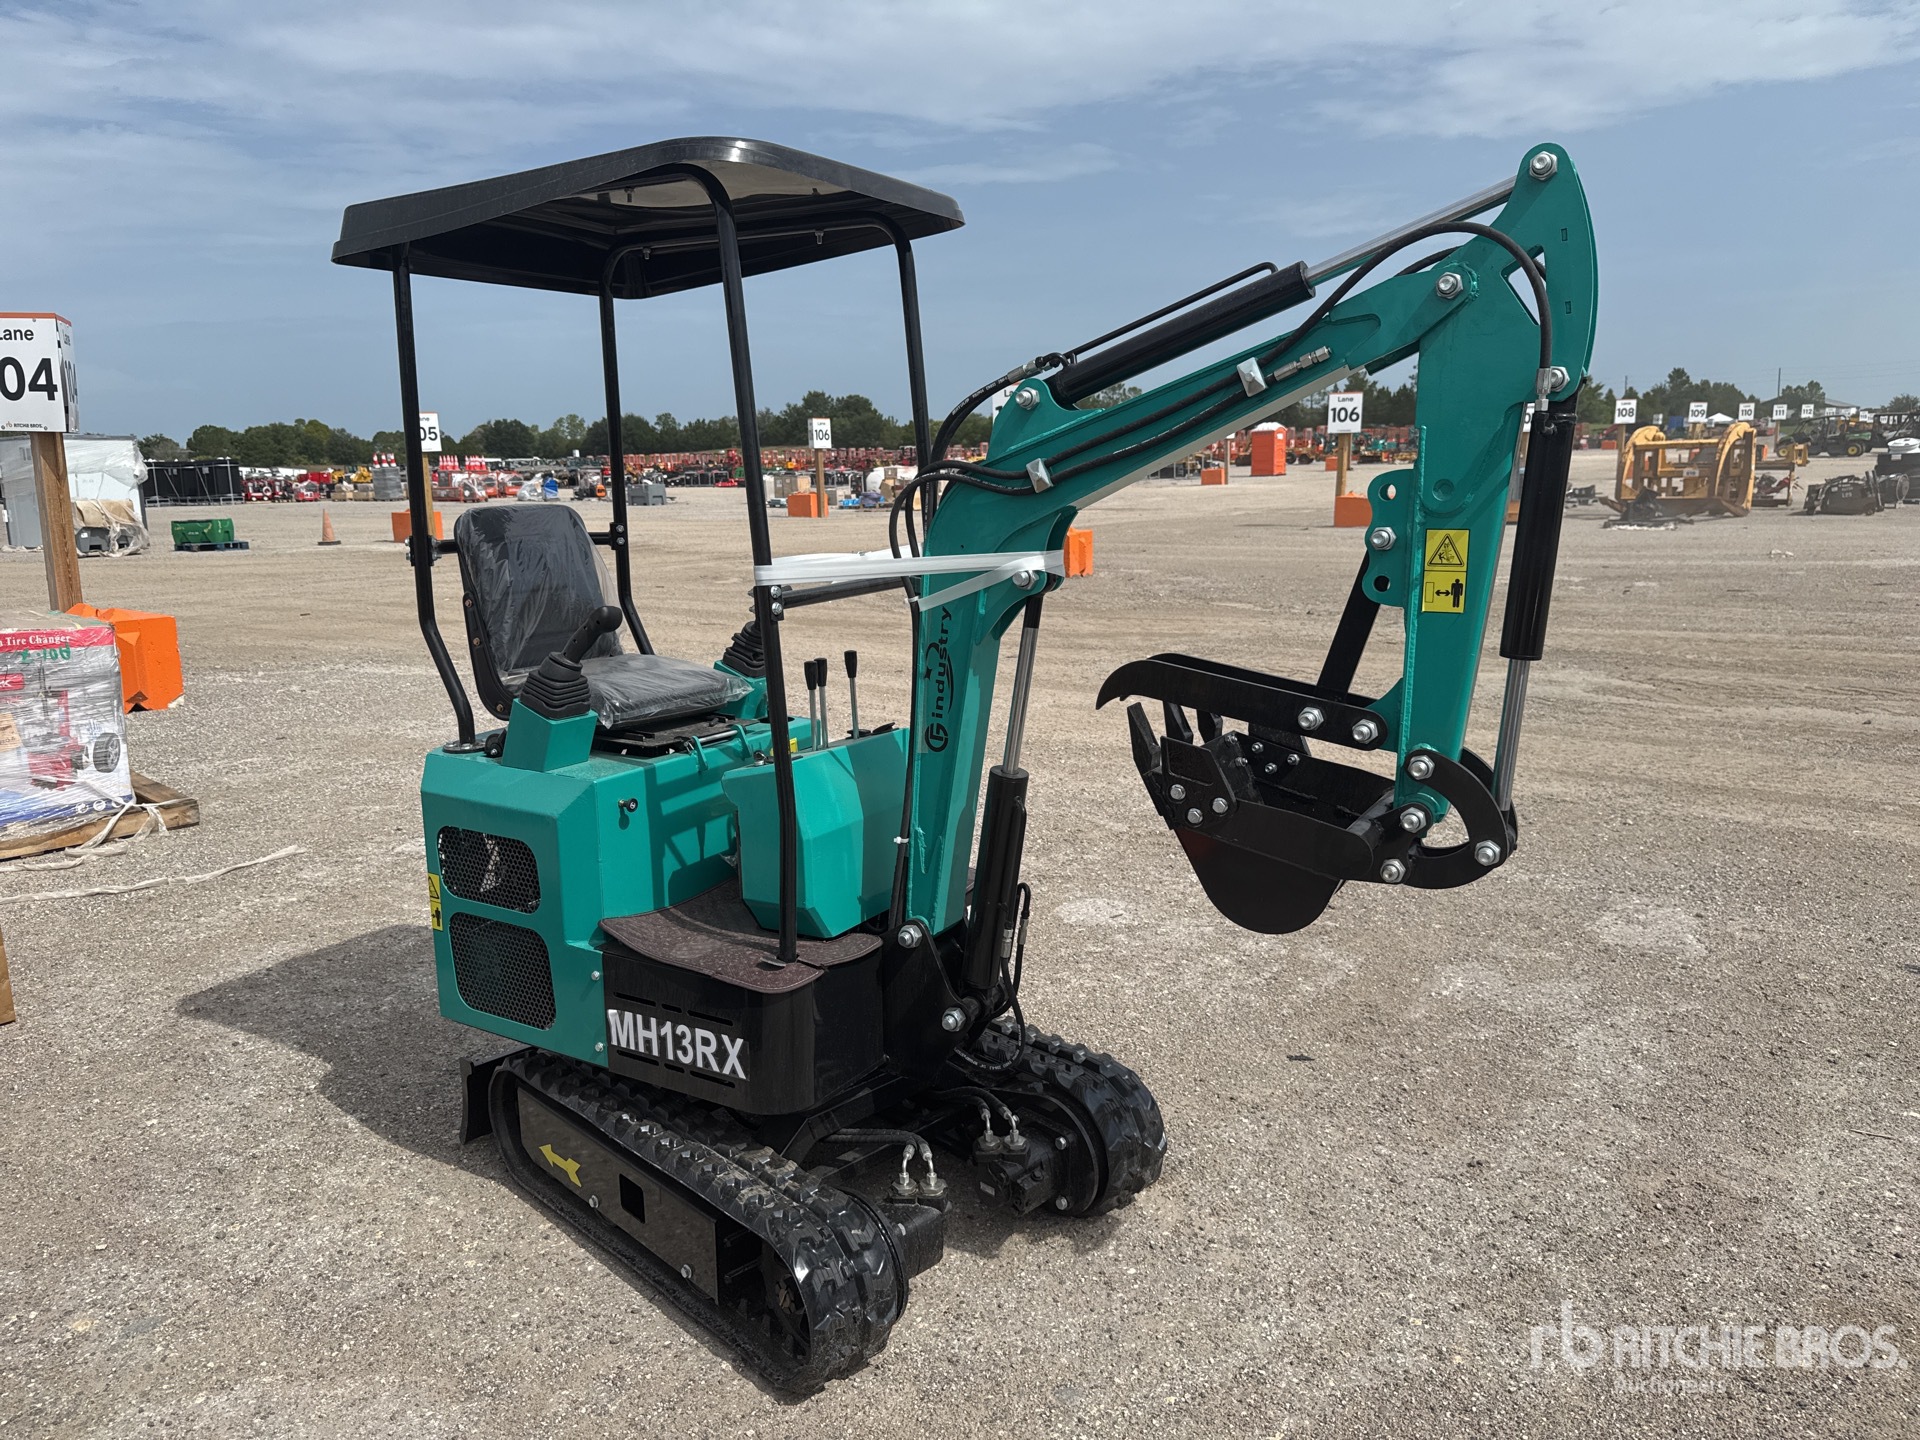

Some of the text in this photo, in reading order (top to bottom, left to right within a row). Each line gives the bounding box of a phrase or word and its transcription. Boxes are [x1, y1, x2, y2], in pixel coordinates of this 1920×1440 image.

[0, 328, 34, 341] ane
[1330, 406, 1360, 423] 106
[1617, 407, 1635, 418] 108
[1690, 408, 1706, 418] 109
[1740, 408, 1753, 417] 110
[814, 429, 830, 441] 106
[5, 636, 27, 647] Tire
[29, 634, 71, 645] Changer
[607, 1008, 746, 1080] MH13RX
